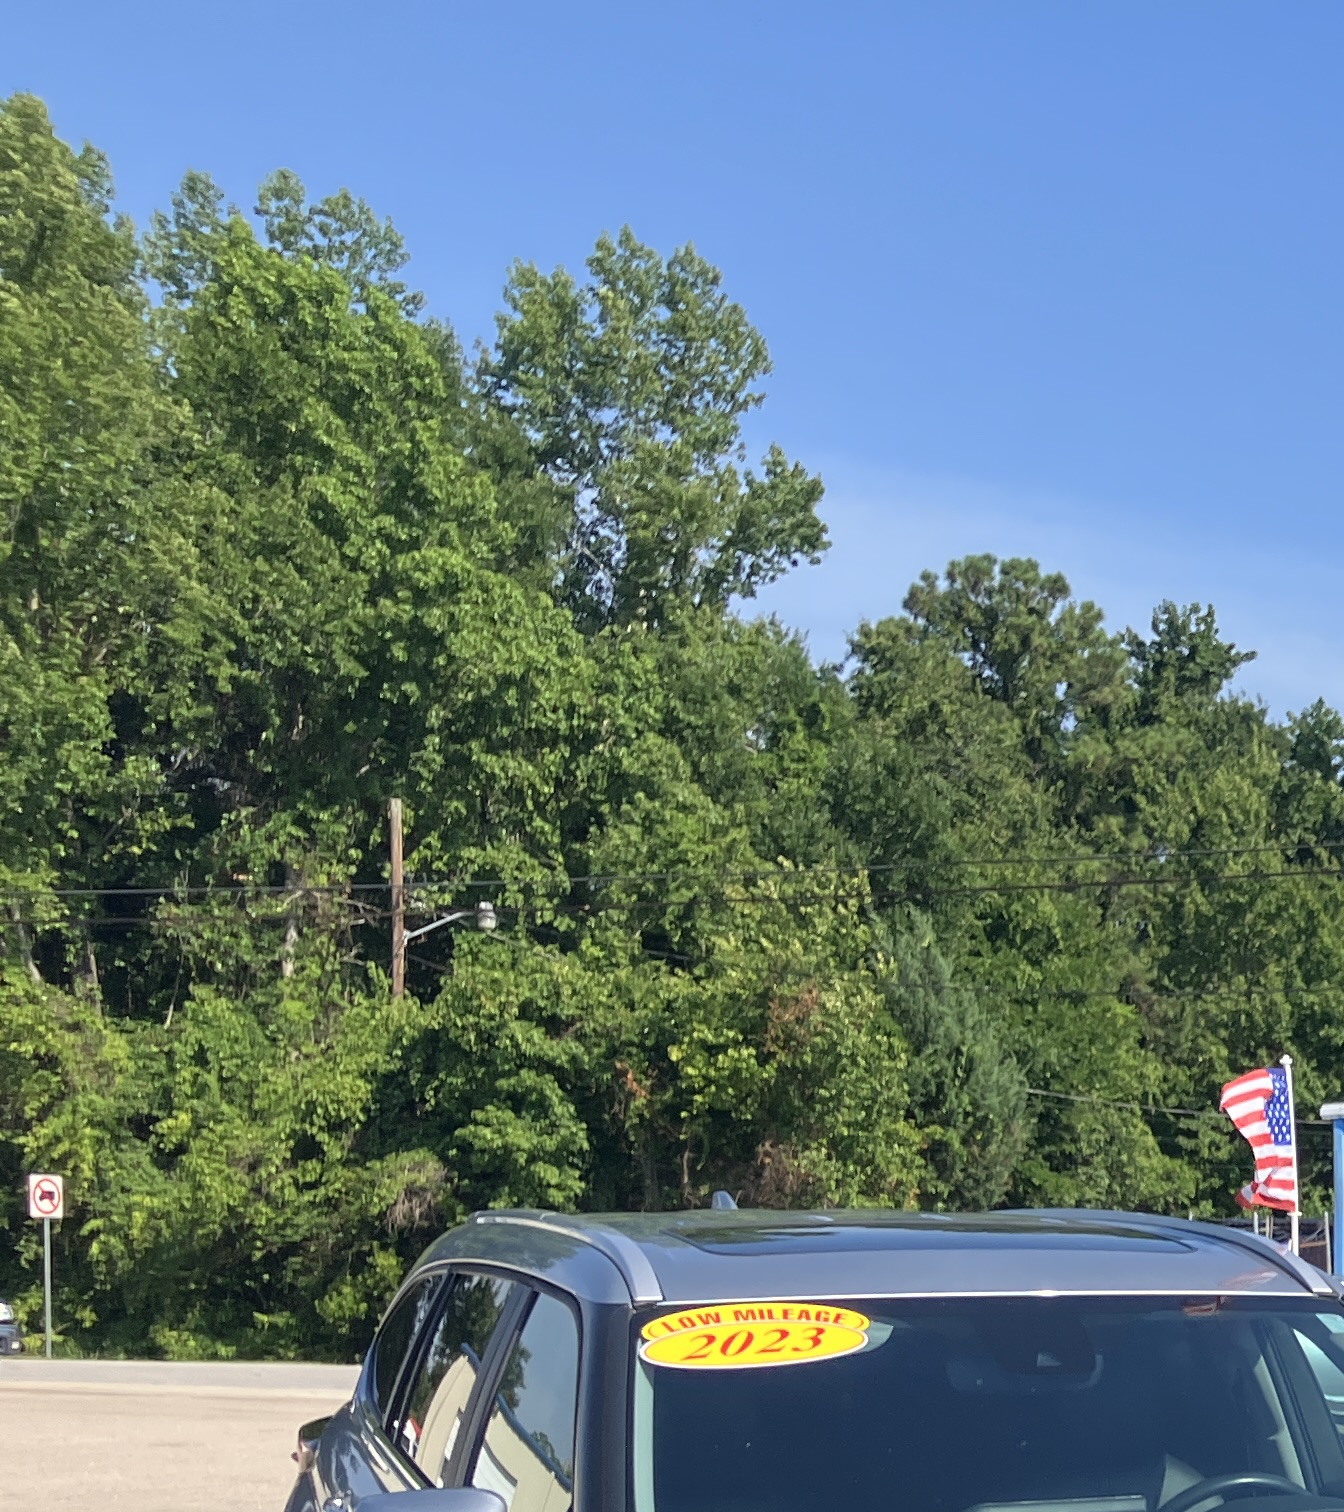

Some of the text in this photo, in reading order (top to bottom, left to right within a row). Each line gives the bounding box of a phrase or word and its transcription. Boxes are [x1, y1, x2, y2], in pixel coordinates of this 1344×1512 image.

[661, 1309, 848, 1333] LOW MILEAGE
[682, 1327, 825, 1360] 2023
